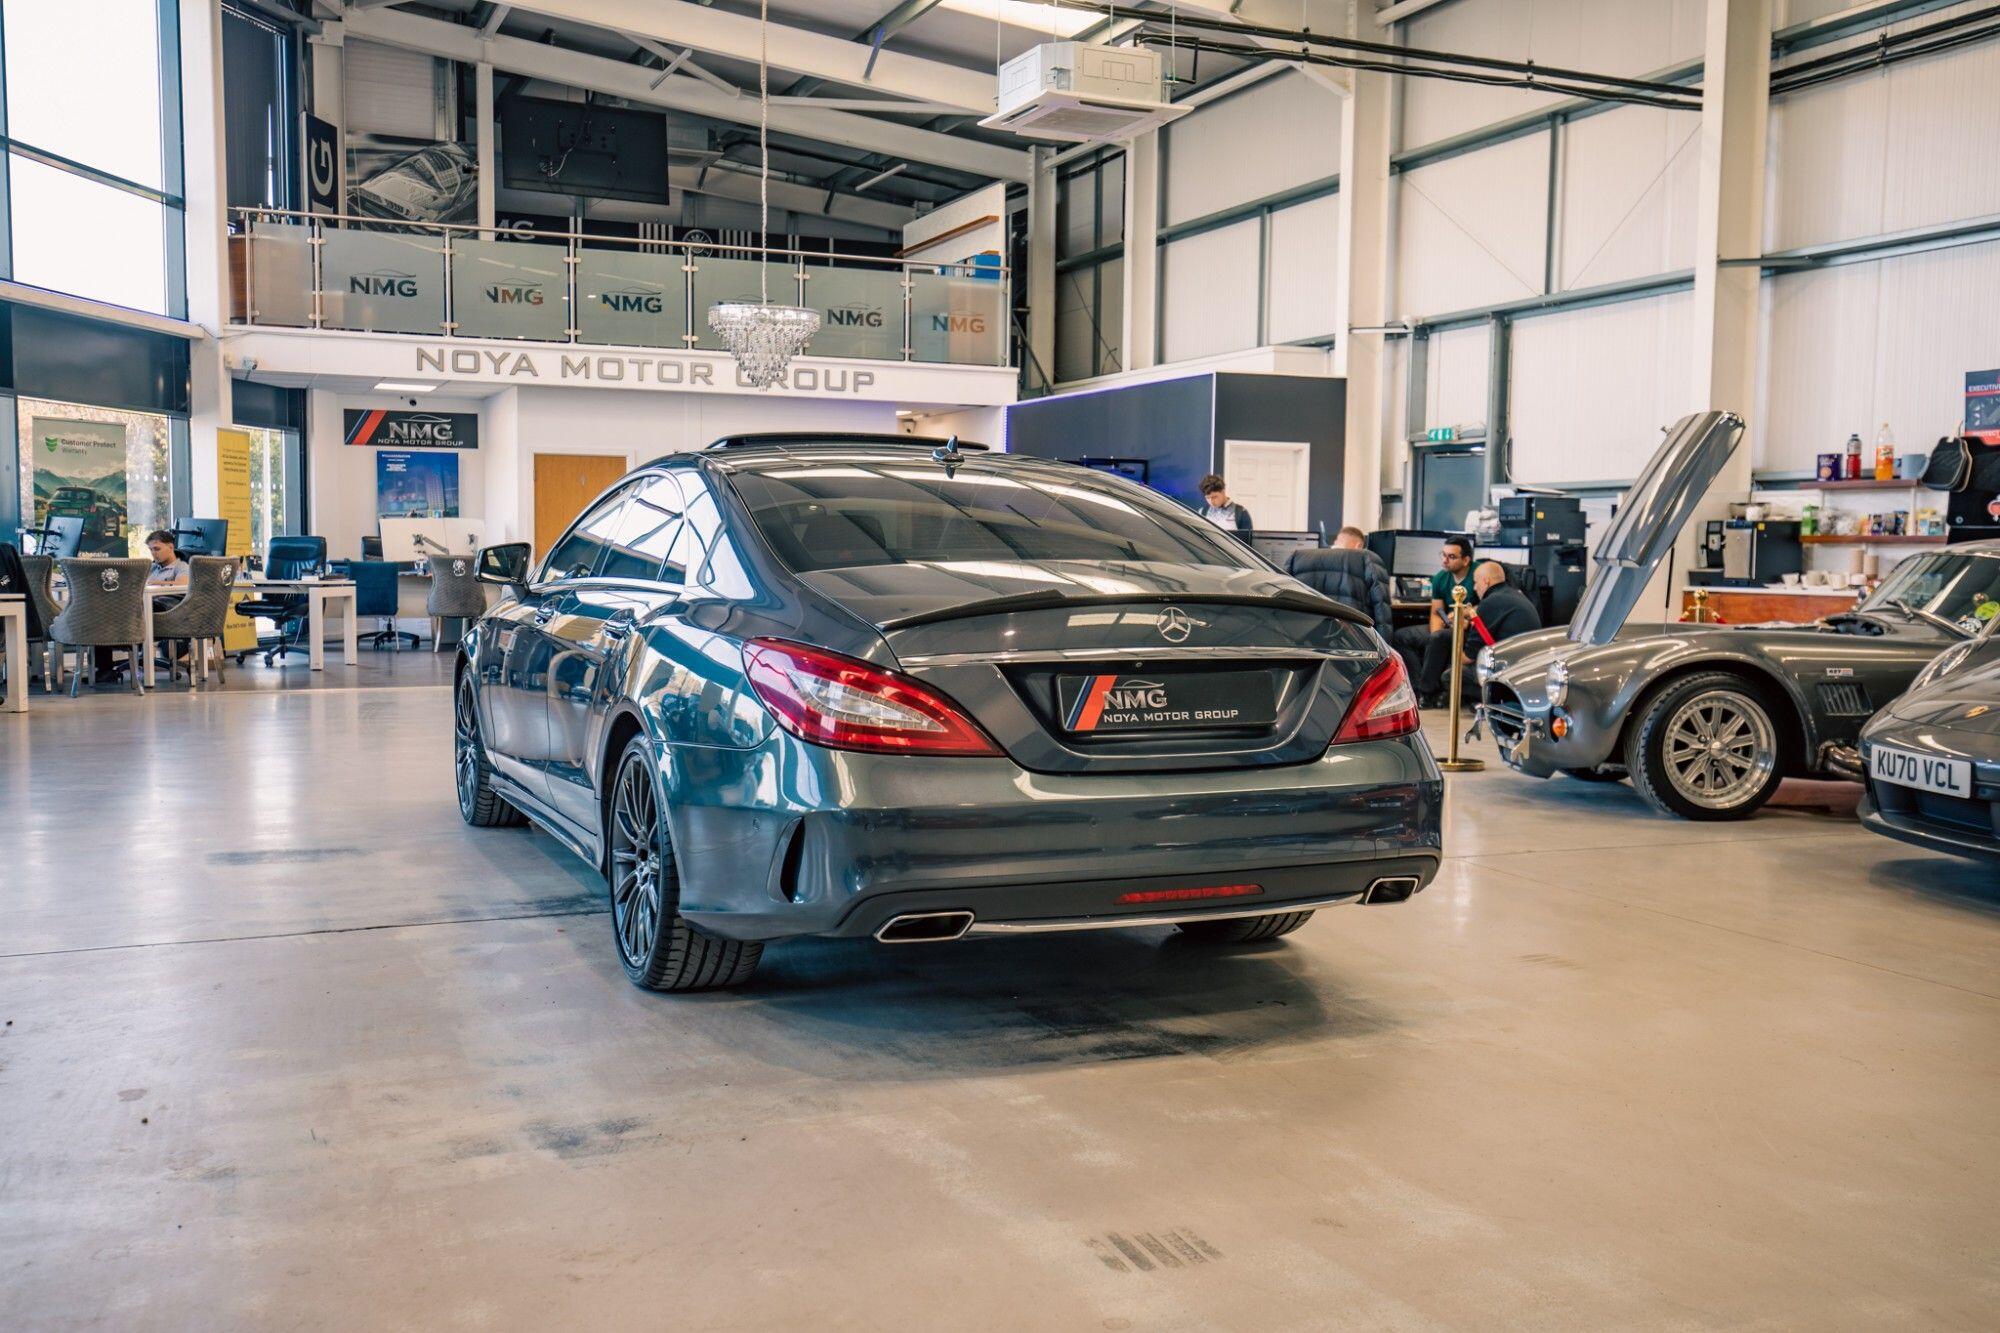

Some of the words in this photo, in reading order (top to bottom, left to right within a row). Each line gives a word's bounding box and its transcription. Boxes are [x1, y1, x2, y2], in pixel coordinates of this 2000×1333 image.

[350, 275, 418, 297] NMG
[482, 286, 544, 306] NMG
[602, 294, 663, 313] NMG
[827, 309, 882, 327] NMG
[932, 315, 985, 333] NMG
[416, 346, 539, 378] NOYA
[561, 355, 714, 385] MOTOR
[388, 422, 453, 440] NMG
[61, 438, 92, 447] Customer
[93, 440, 116, 448] Protect
[1102, 689, 1168, 710] NMG
[1104, 713, 1139, 723] NOYA
[1144, 712, 1189, 722] MOTOR
[1194, 709, 1239, 720] GROUP
[1877, 749, 1918, 782] KU70
[1923, 759, 1960, 791] VCL
